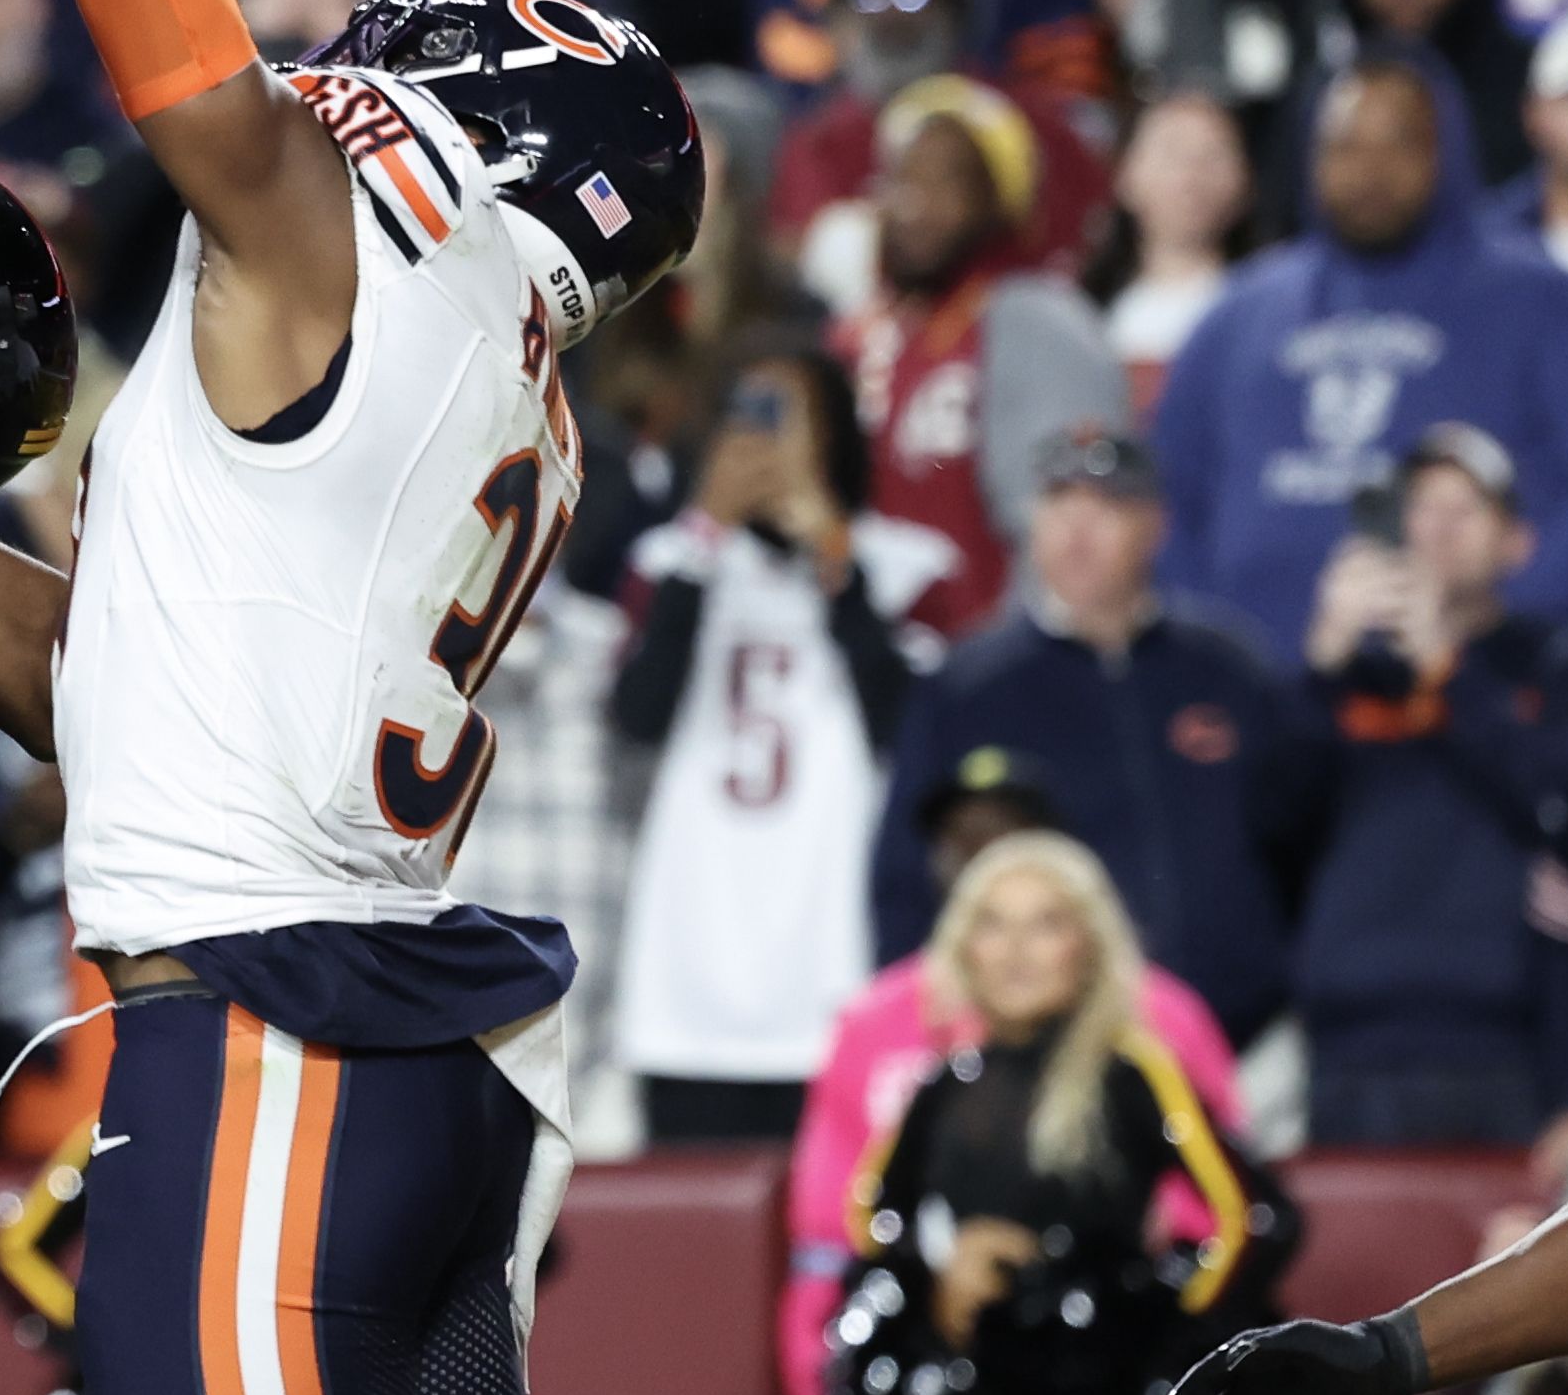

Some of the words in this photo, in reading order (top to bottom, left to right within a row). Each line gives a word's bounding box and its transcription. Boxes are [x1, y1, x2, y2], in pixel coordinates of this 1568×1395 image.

[550, 266, 585, 320] STOP
[373, 446, 573, 867] 3
[722, 641, 796, 809] 5
